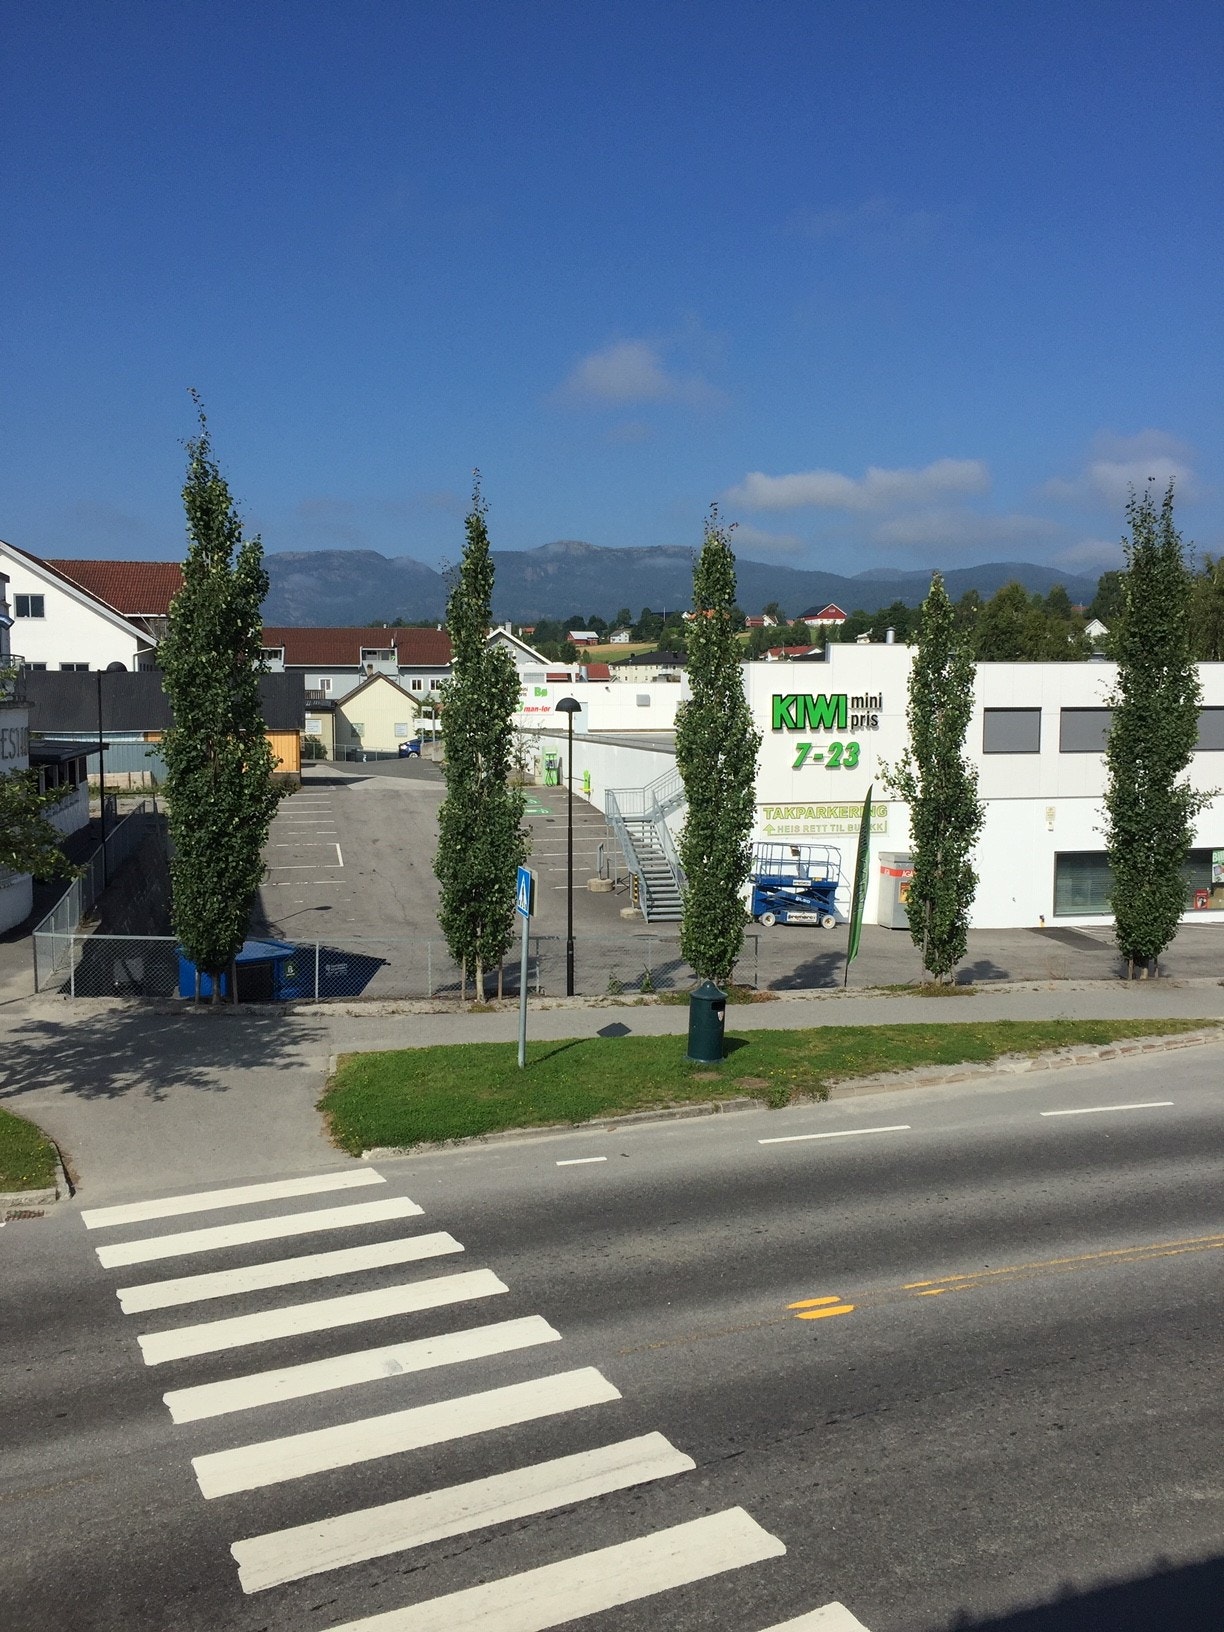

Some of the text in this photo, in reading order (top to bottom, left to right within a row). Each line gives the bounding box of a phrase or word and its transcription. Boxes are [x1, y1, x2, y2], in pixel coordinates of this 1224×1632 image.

[534, 687, 548, 697] Bø
[772, 692, 883, 730] KIWI mini
[850, 711, 879, 730] pris
[792, 742, 861, 768] 7-23
[777, 822, 884, 833] HEIS RETT TIL BUKK
